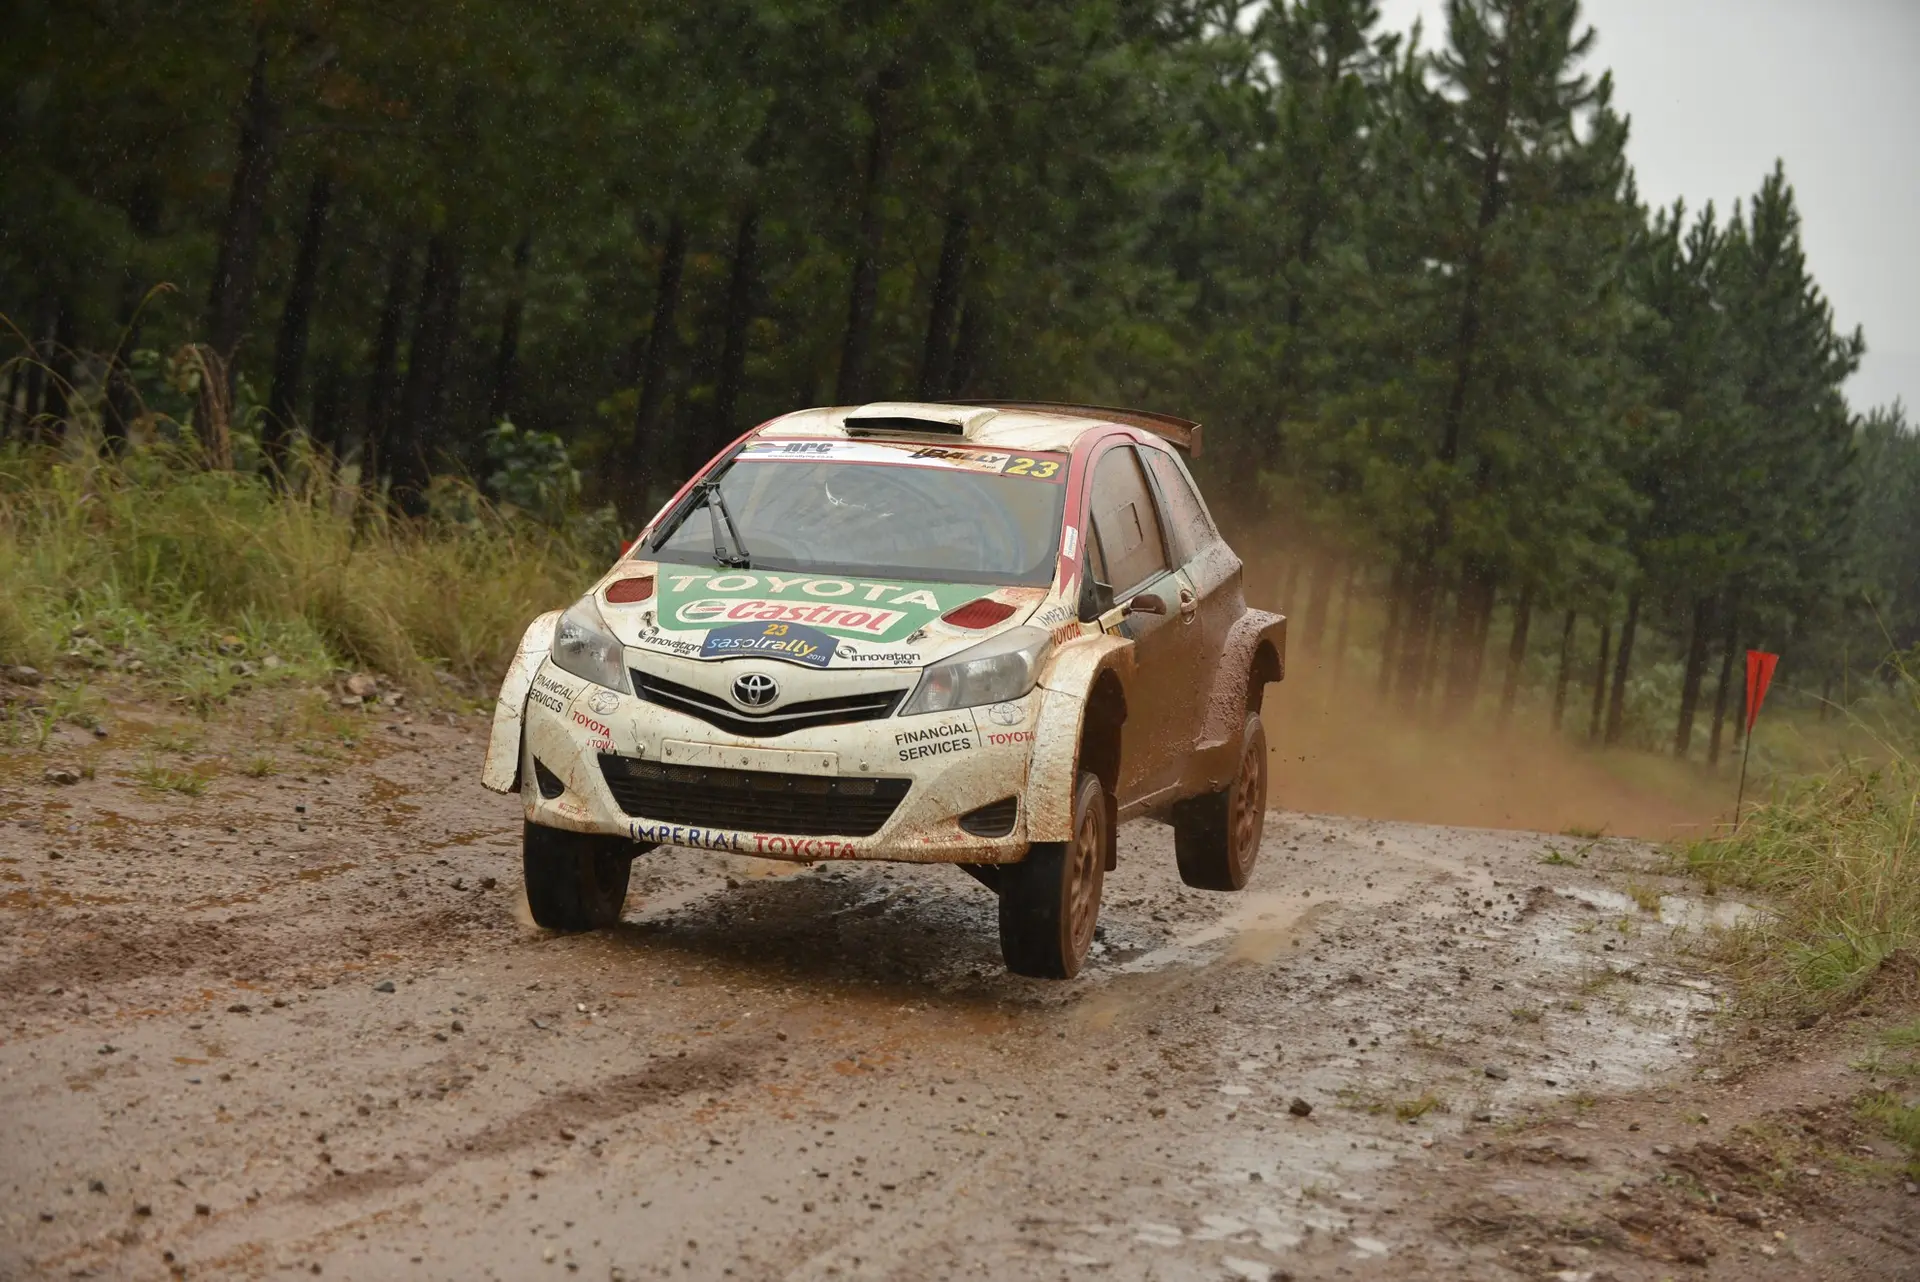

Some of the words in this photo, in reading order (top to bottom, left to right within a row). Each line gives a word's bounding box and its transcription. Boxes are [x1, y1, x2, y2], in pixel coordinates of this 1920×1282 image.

[1005, 457, 1060, 478] 23
[668, 575, 940, 611] TOYOTA
[727, 601, 893, 631] Castrol
[762, 623, 789, 636] 23
[645, 635, 702, 652] innovation
[673, 648, 690, 656] group
[852, 651, 920, 663] innovation
[535, 674, 574, 700] FINANCIAL
[530, 688, 563, 713] ERVICES
[573, 711, 611, 738] TOYOTA
[895, 723, 972, 745] FINANCIAL
[592, 740, 611, 749] TOW
[987, 731, 1035, 745] TOYOTA
[899, 738, 971, 762] SERVICES
[629, 823, 744, 850] IMPERIAL
[753, 835, 856, 858] TOYOTA
